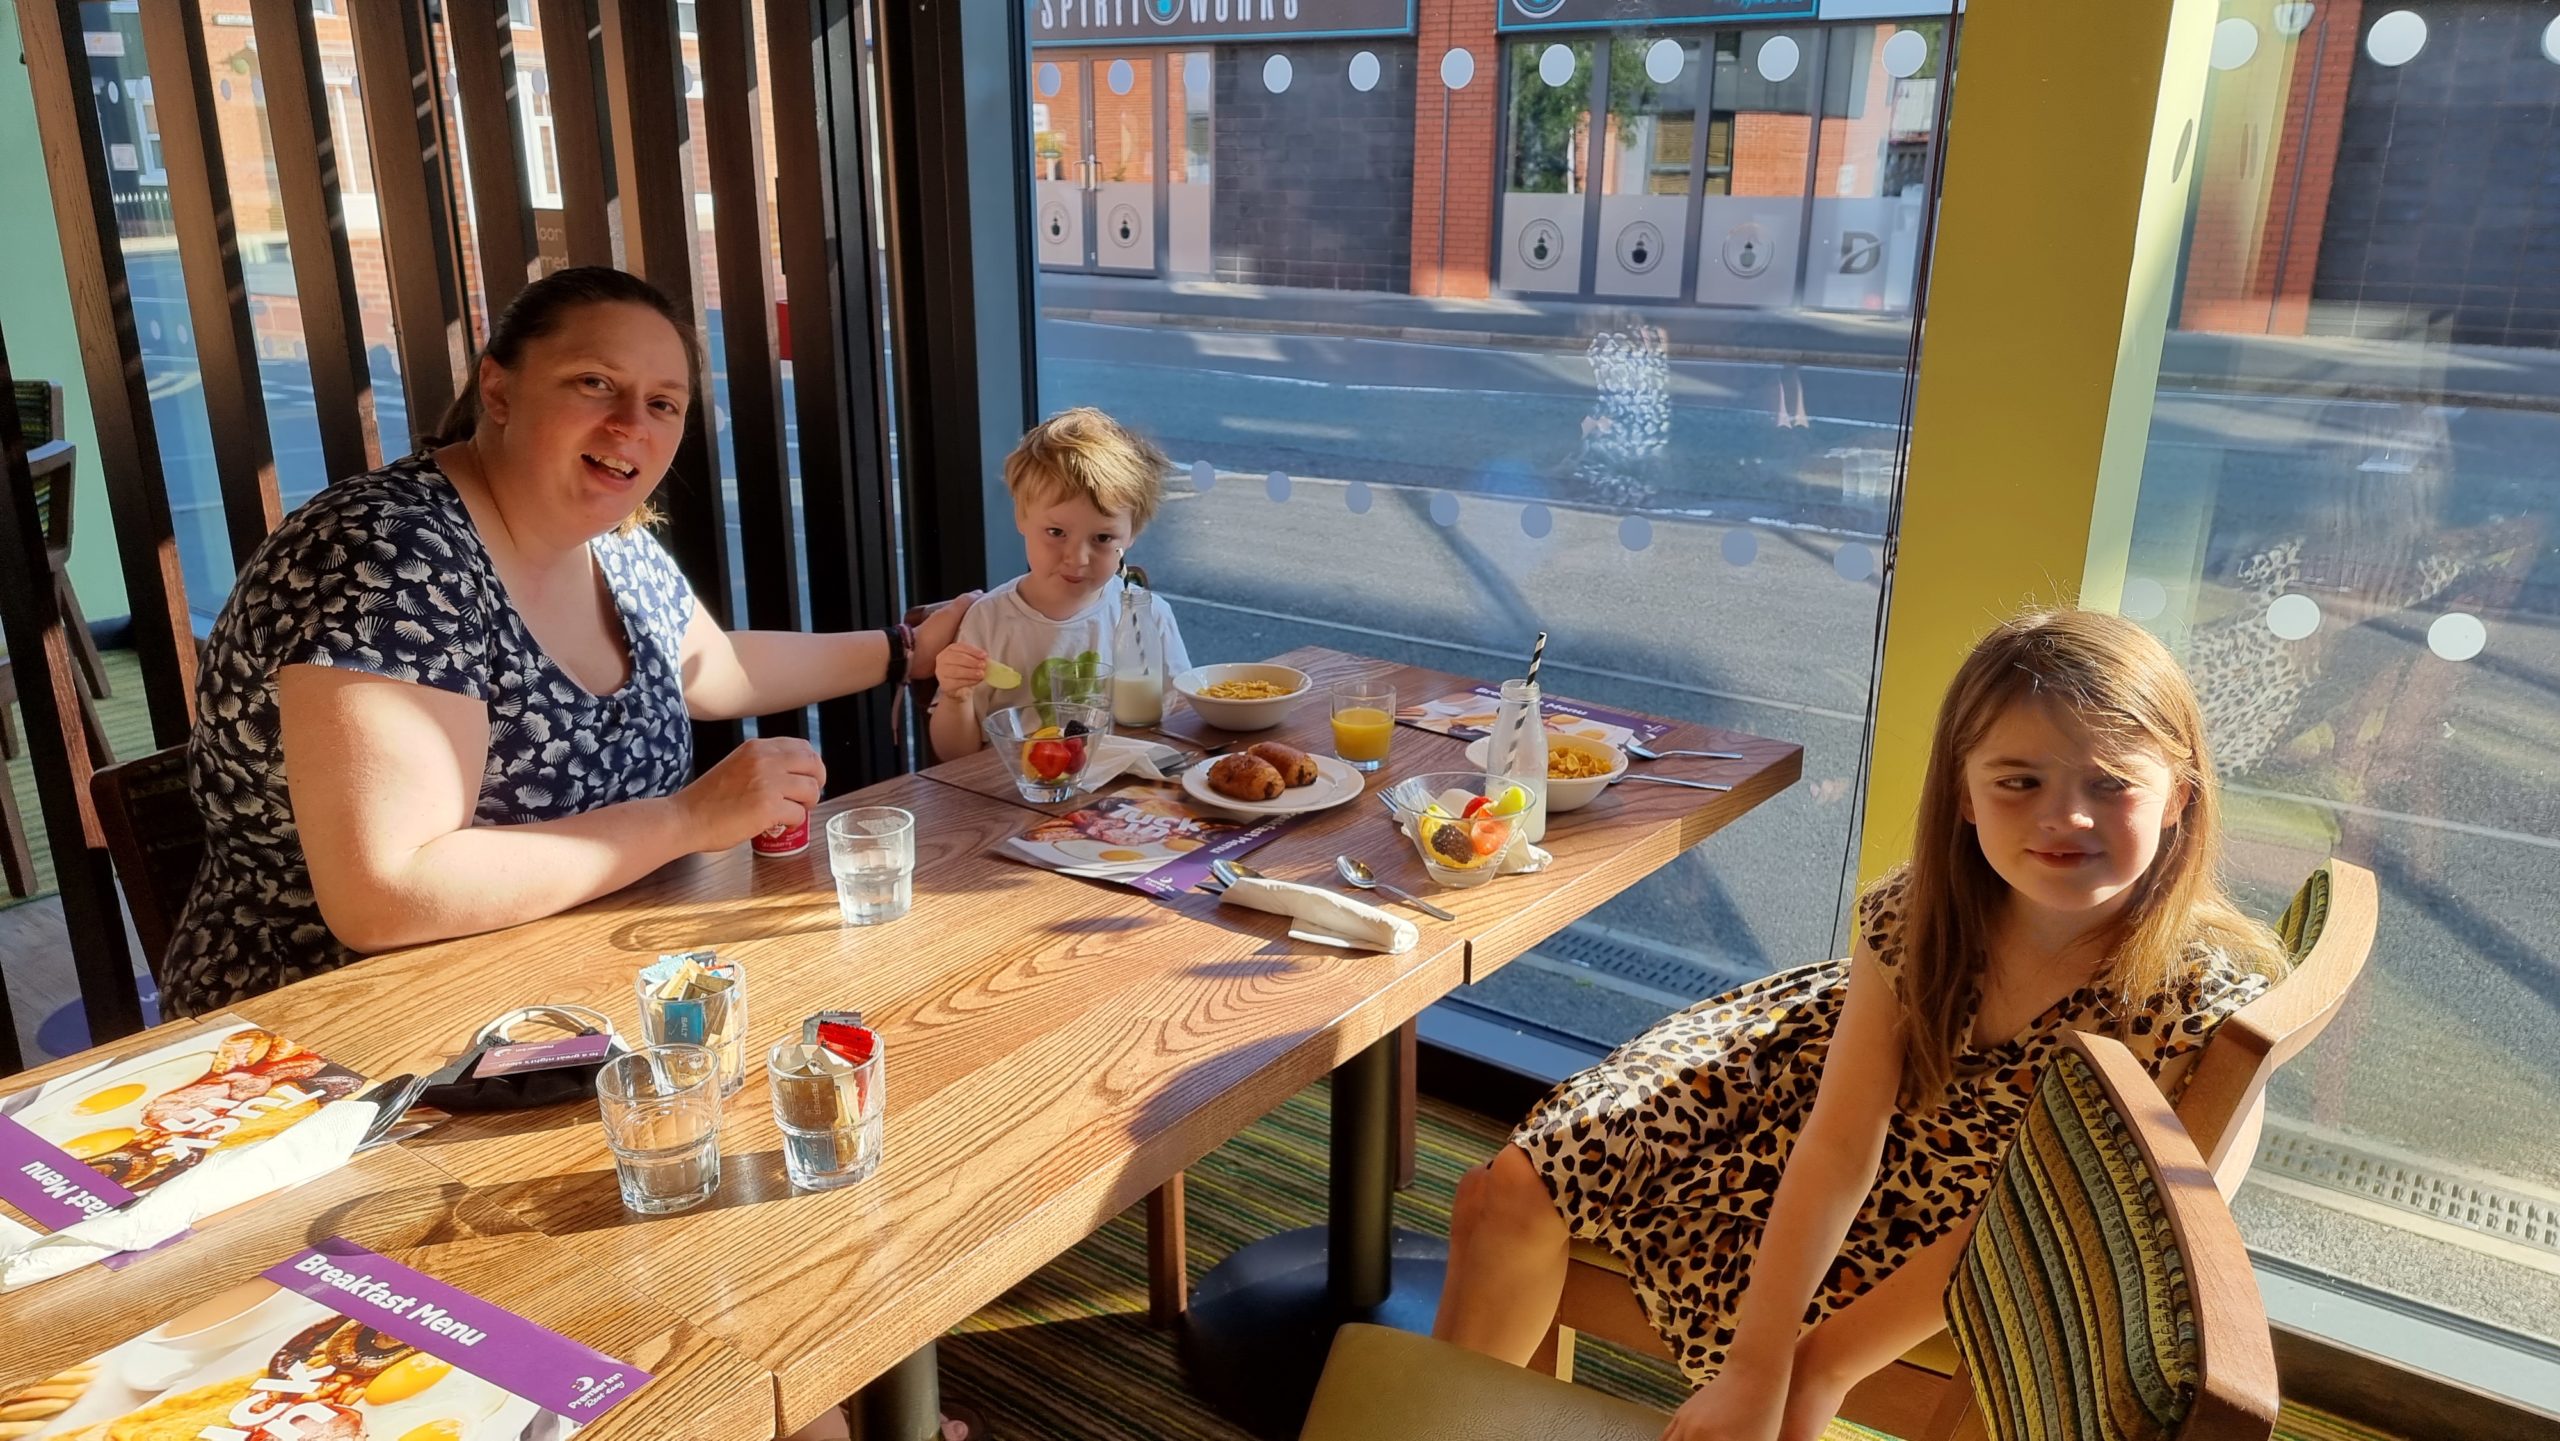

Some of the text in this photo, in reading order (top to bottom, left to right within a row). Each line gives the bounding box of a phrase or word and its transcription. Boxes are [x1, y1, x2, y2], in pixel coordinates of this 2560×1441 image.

[1041, 0, 1139, 29] SPIRIT
[20, 1160, 80, 1200] Menu
[293, 1252, 488, 1348] Breakfast Menu
[567, 1372, 624, 1410] Premier Inn
[584, 1392, 606, 1409] Rest
